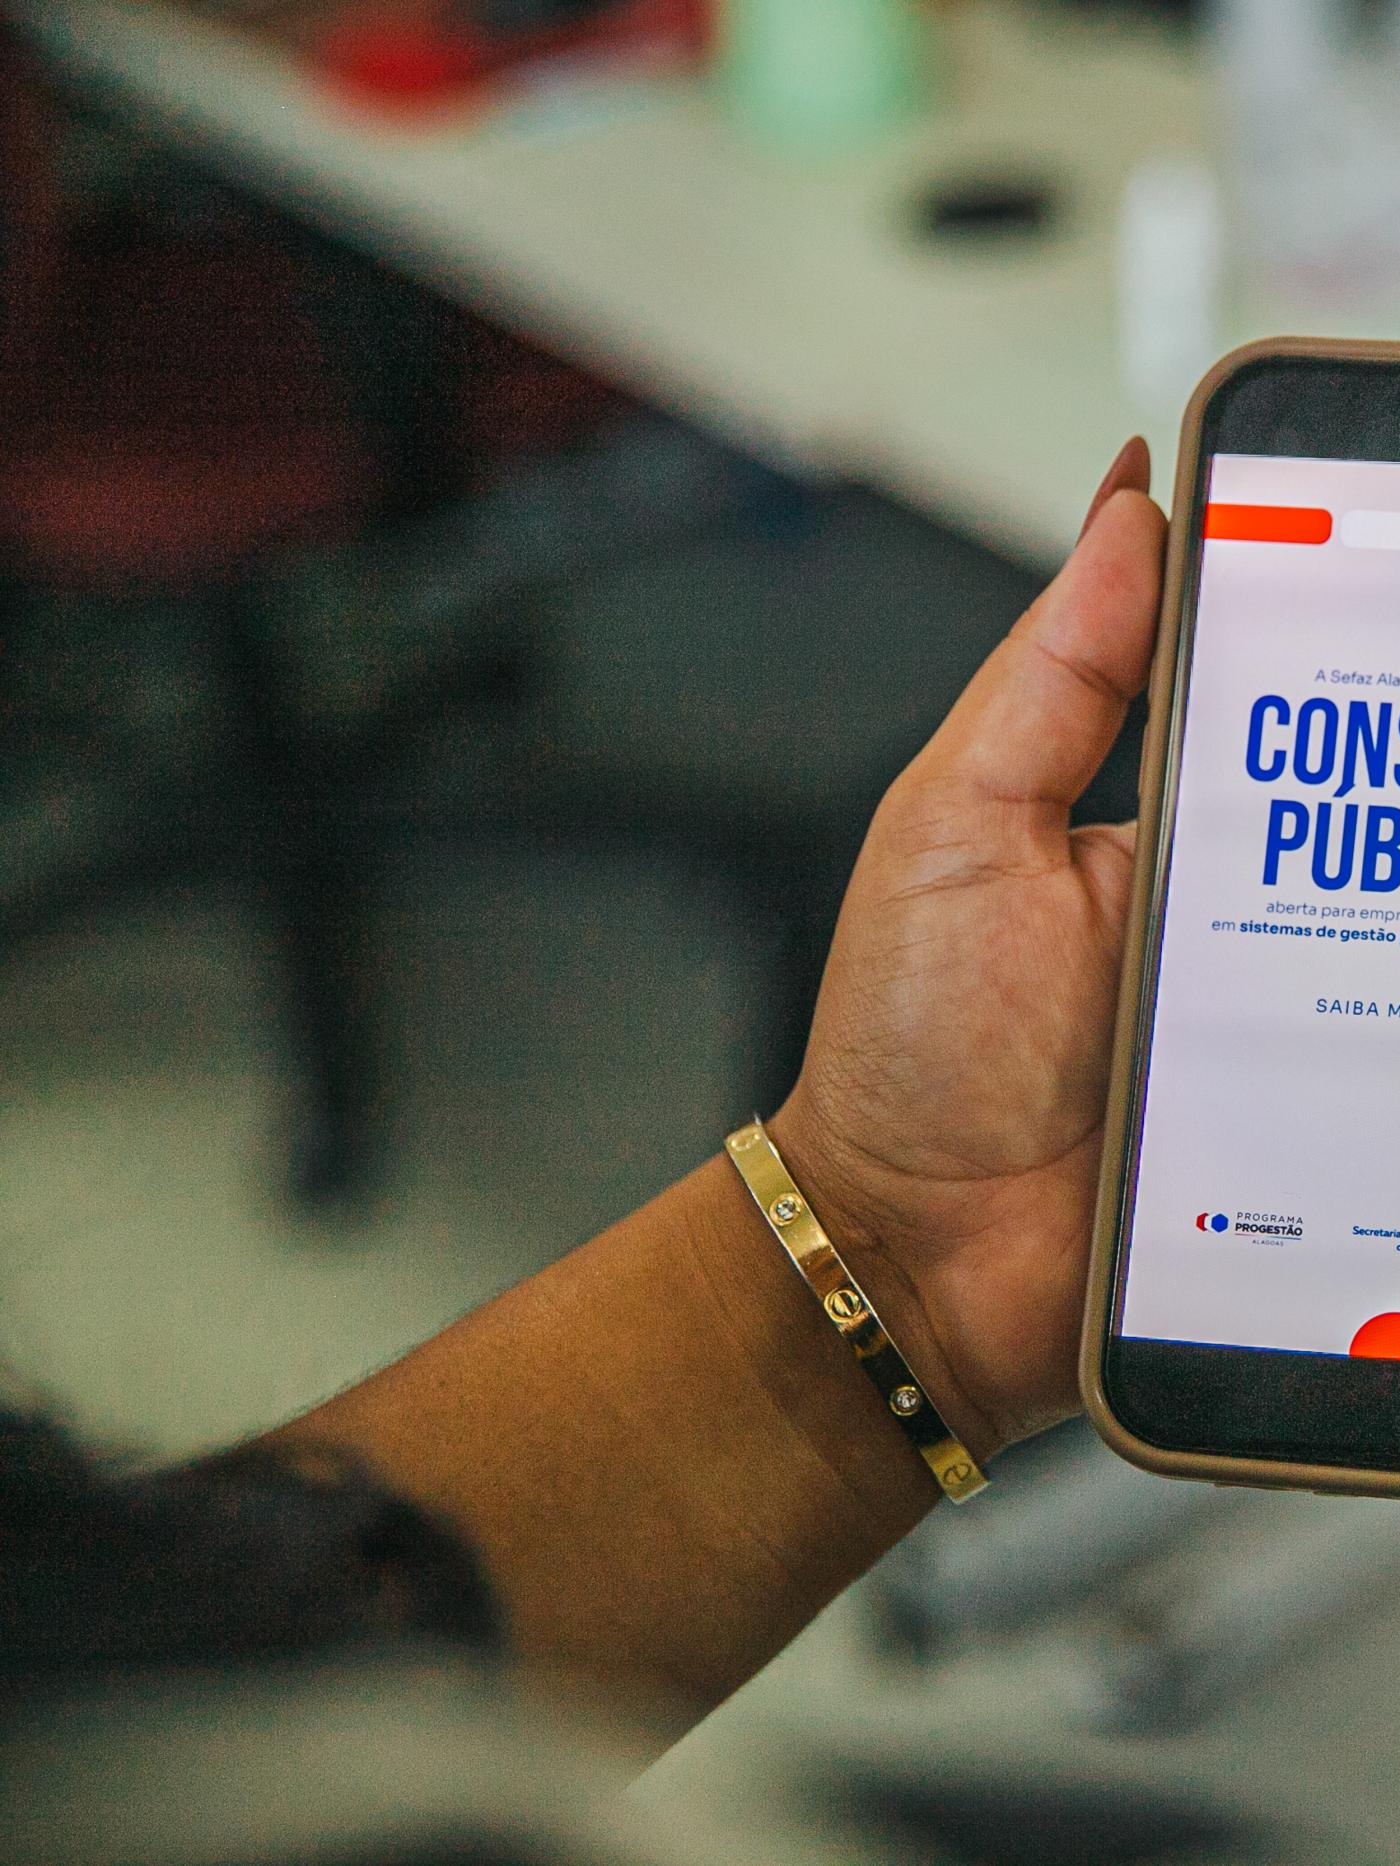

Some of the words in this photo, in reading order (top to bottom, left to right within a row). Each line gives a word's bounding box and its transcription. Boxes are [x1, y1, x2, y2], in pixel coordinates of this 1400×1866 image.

[1315, 669, 1326, 682] A
[1330, 670, 1373, 686] Sefaz
[1266, 900, 1317, 917] aberta
[1321, 906, 1356, 922] para
[1211, 919, 1236, 932] em
[1240, 921, 1313, 937] sistemas
[1315, 925, 1337, 938] de
[1340, 927, 1396, 944] gestão
[1315, 998, 1380, 1017] SAIBA
[1236, 1211, 1304, 1225] PROGRAMA
[1234, 1222, 1303, 1237] PROGESTÃO
